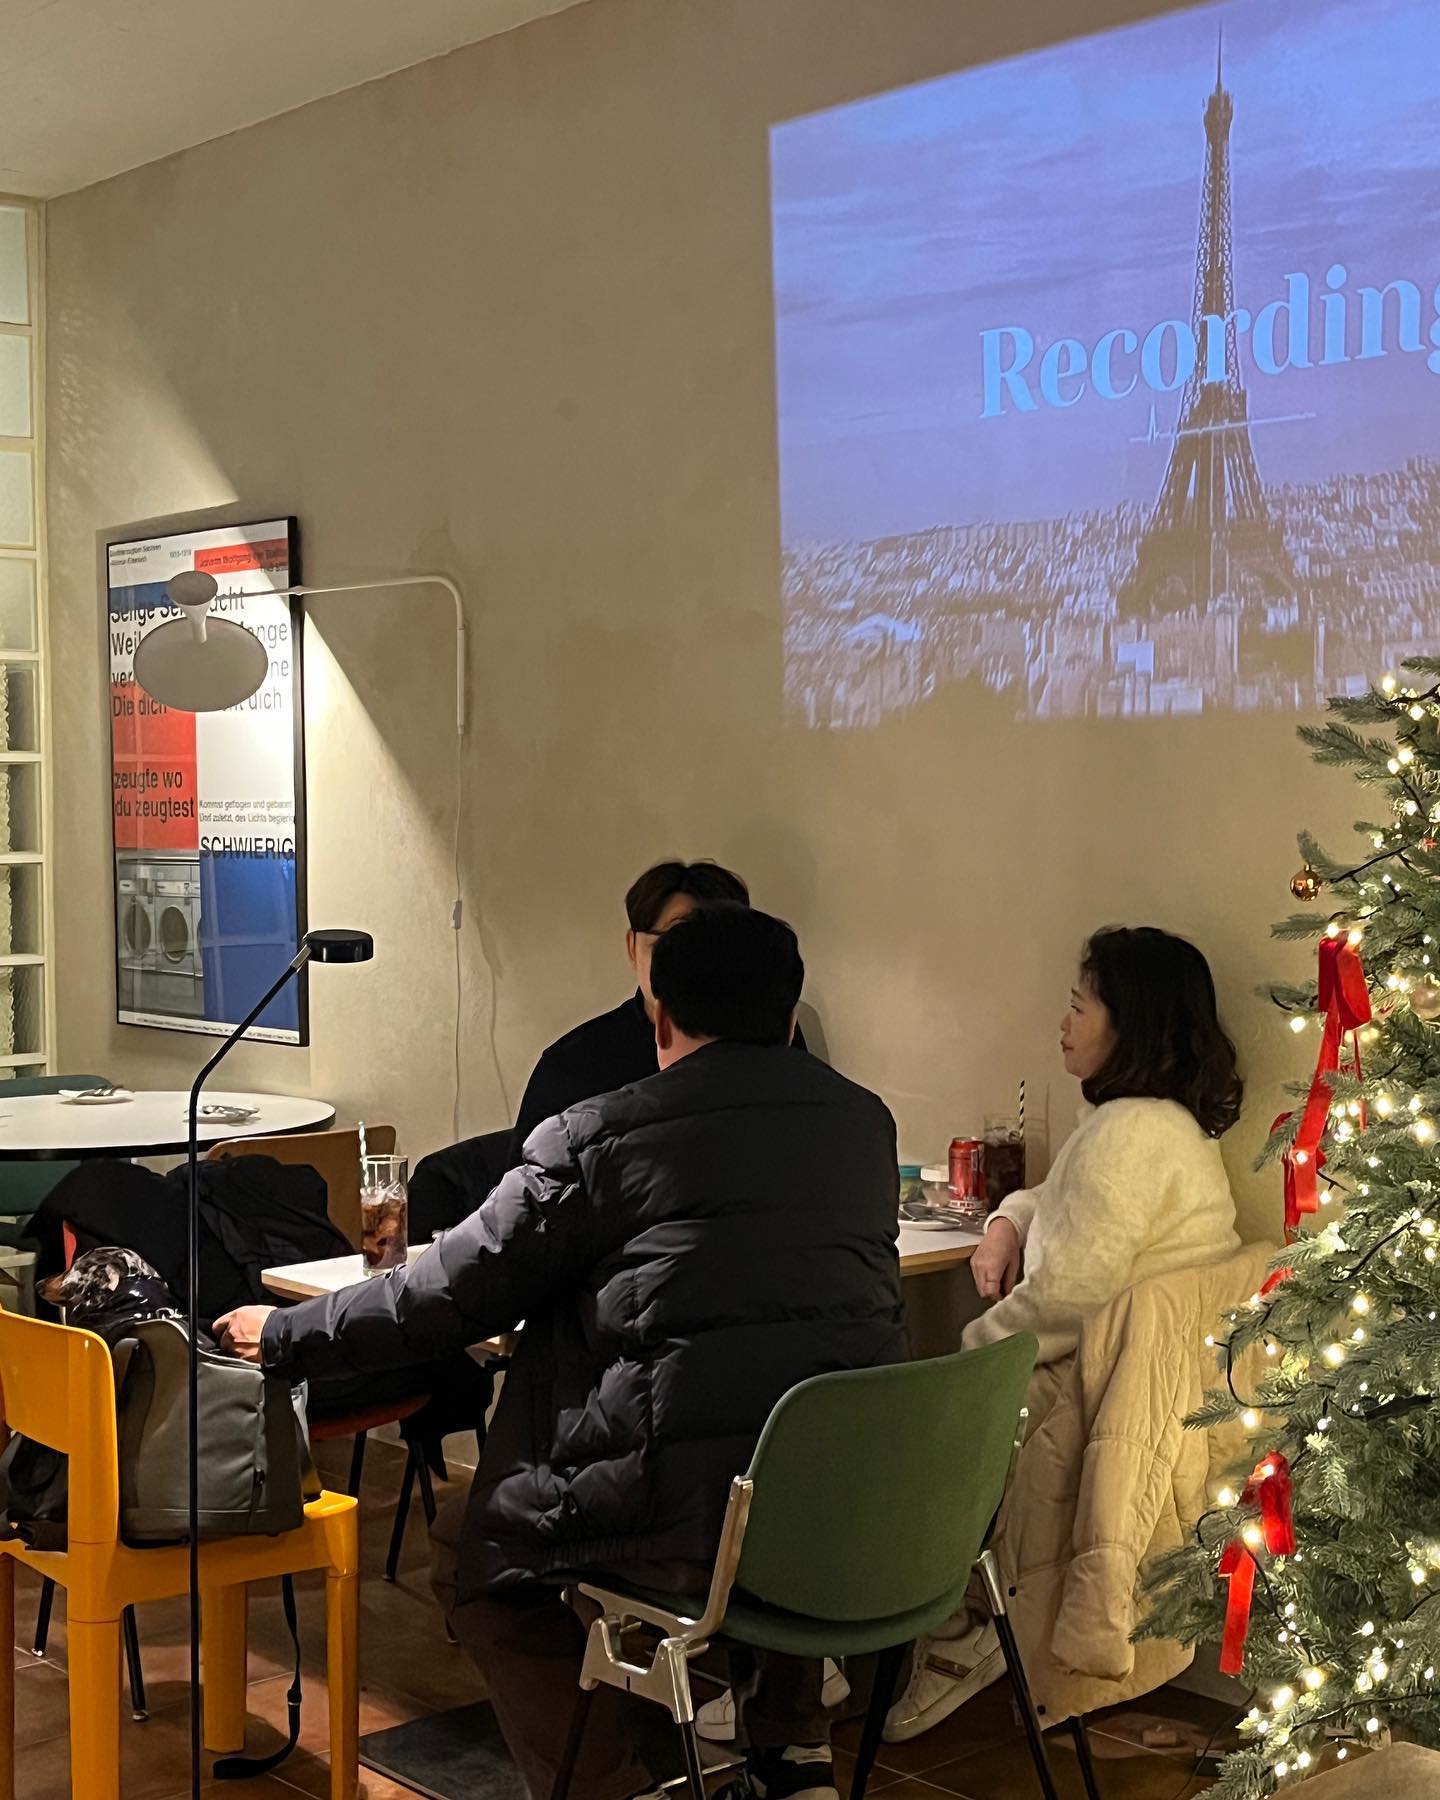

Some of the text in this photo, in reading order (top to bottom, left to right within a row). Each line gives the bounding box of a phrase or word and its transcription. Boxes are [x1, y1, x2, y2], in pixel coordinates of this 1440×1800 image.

[113, 694, 135, 717] Die
[114, 769, 183, 794] zeugte wo
[114, 797, 195, 823] du zeugtest
[200, 836, 295, 862] SCHWIERIG
